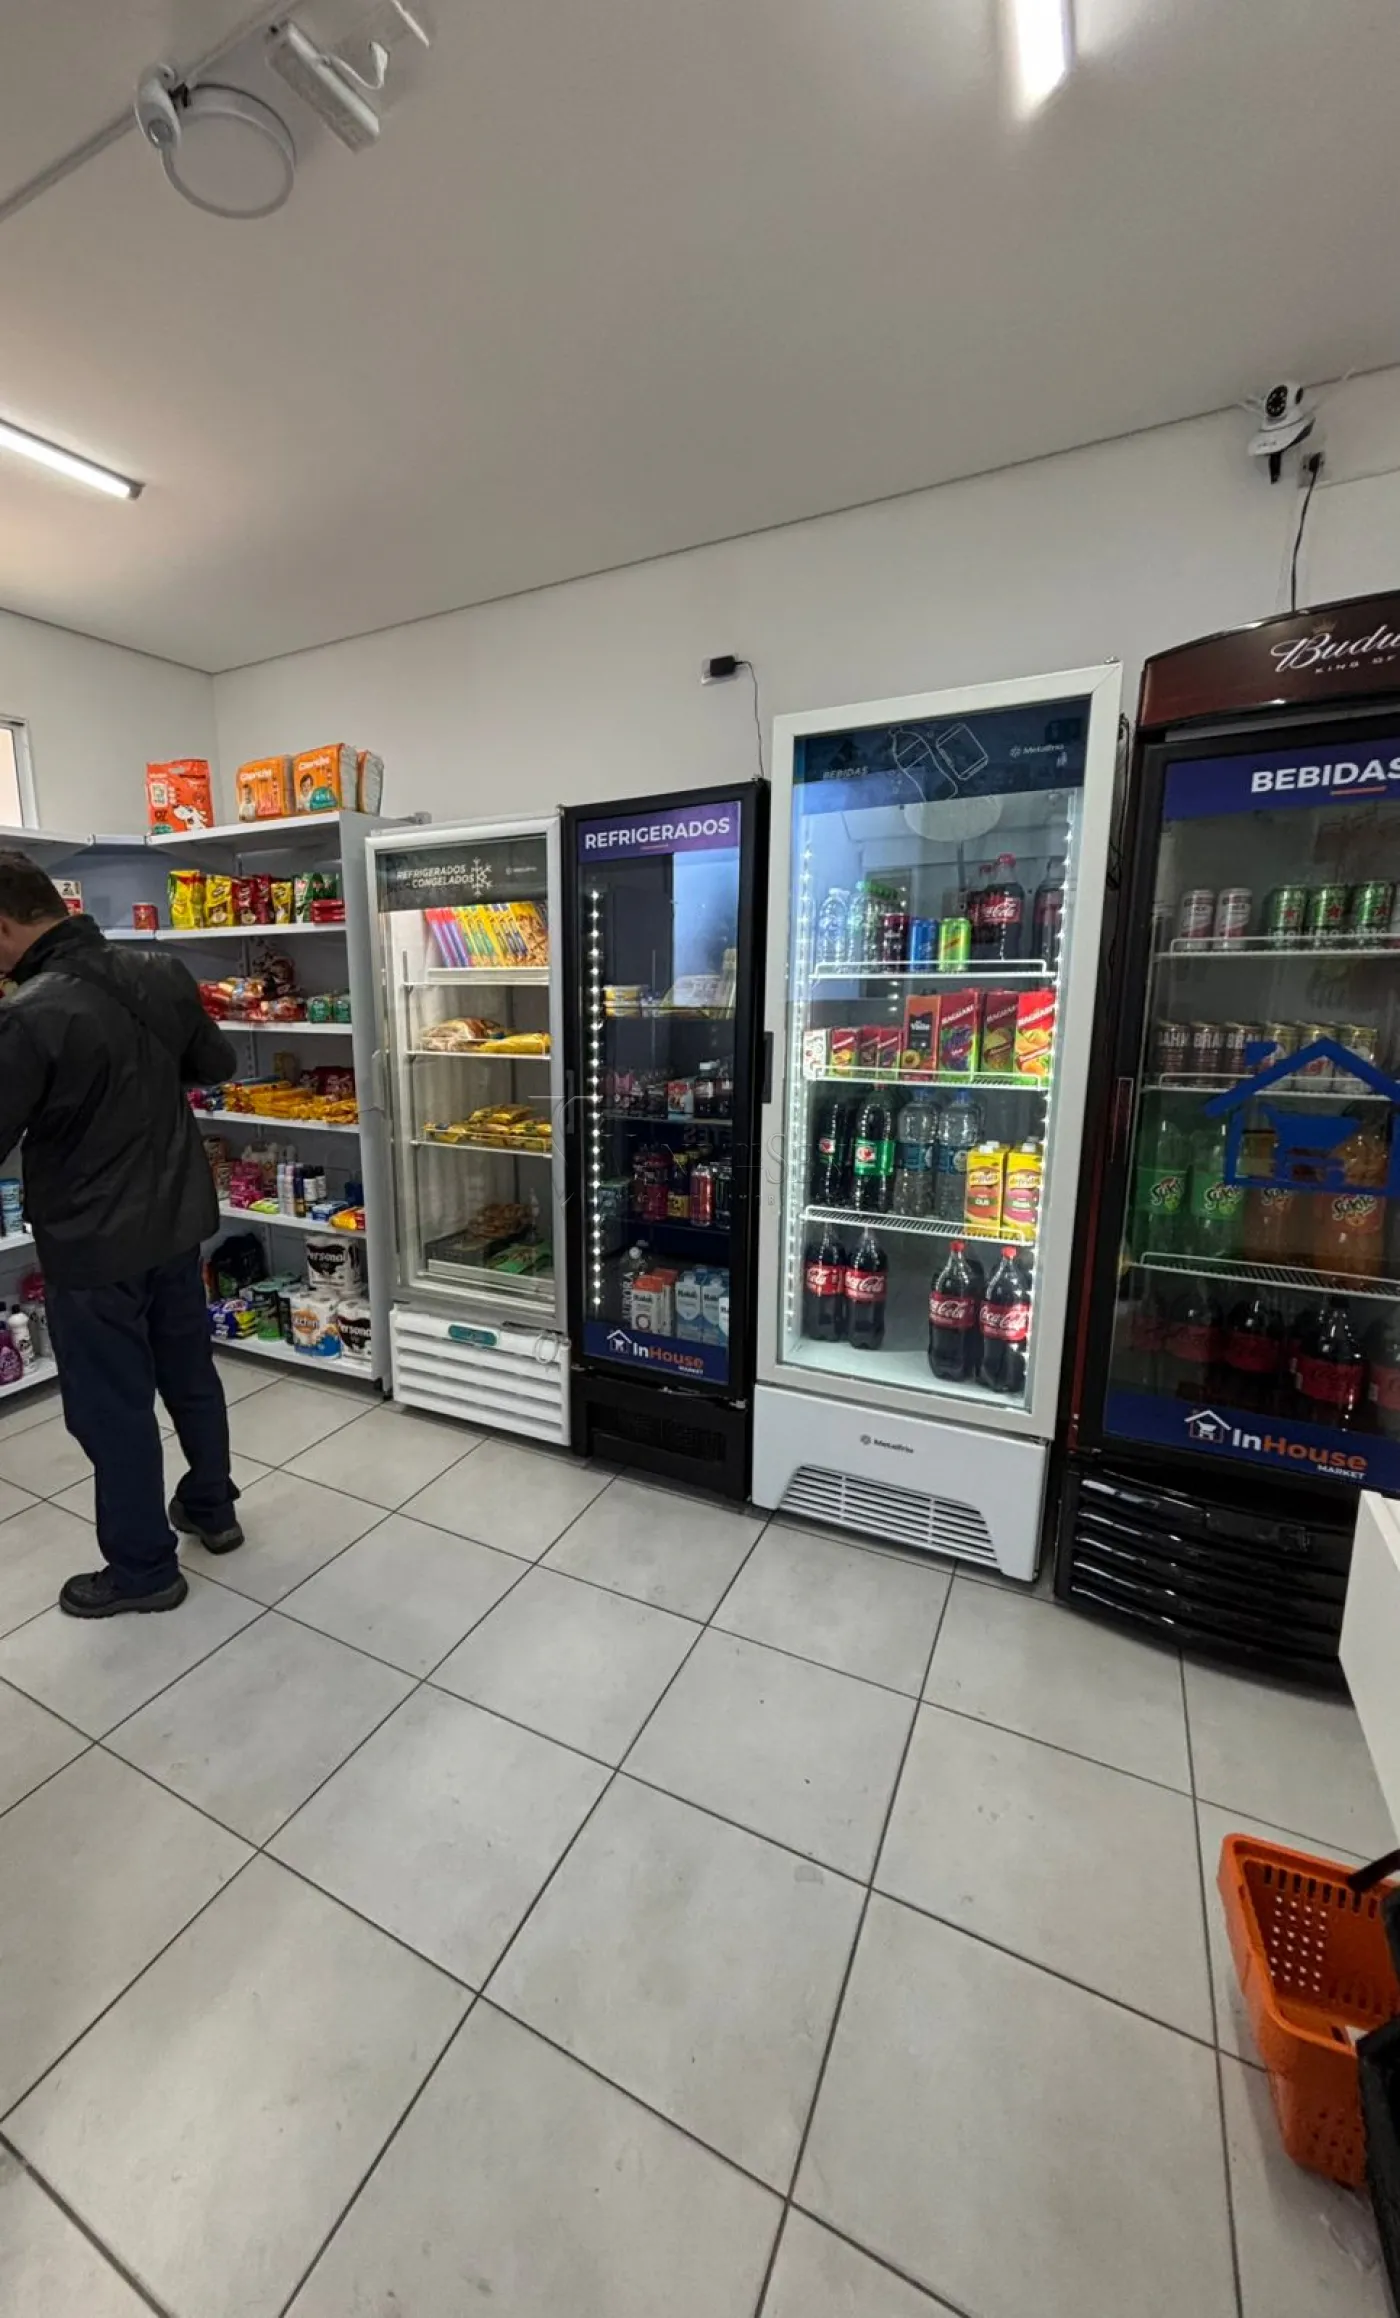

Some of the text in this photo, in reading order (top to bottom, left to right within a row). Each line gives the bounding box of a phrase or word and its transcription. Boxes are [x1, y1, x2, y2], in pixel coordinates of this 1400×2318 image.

[1315, 661, 1359, 674] KING
[823, 766, 869, 779] BEBIDAS
[1251, 757, 1400, 793] BEBIDAS
[585, 817, 730, 849] REFRIGERADOS
[396, 864, 466, 880] REFRIGERADOS
[412, 875, 475, 888] CONGELADOS
[633, 1342, 704, 1369] InHouse
[1232, 1429, 1369, 1471] InHouse
[1317, 1464, 1367, 1480] MARKET
